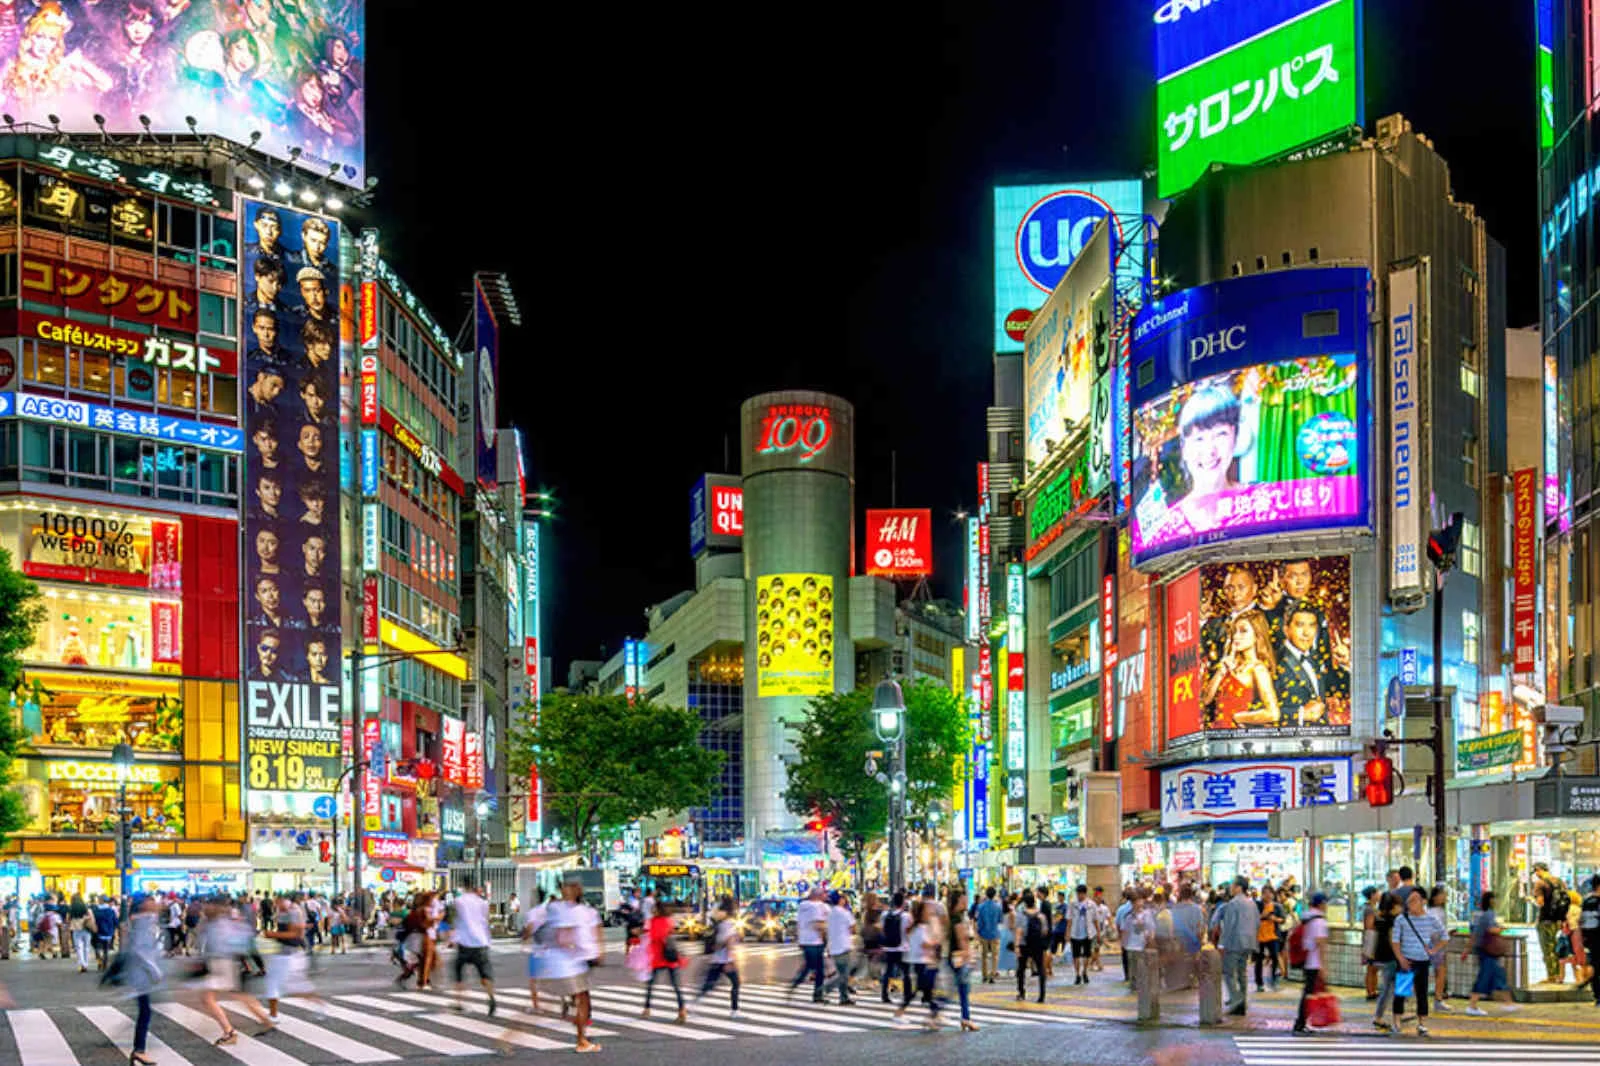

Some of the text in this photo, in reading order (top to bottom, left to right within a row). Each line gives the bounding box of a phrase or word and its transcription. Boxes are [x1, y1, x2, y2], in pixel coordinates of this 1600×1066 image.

[1164, 43, 1339, 151] サロンパス
[23, 260, 193, 319] コンタクト
[1151, 300, 1189, 329] Channel
[144, 336, 220, 374] ガスト
[1190, 325, 1247, 362] DHC
[23, 396, 239, 445] AEON 英会話イーオン
[1393, 304, 1414, 508] Taisei neon
[756, 417, 833, 463] 109
[717, 492, 743, 510] UN
[40, 511, 134, 545] 1000%
[879, 516, 918, 542] H&M
[41, 536, 134, 559] WEDDING!
[895, 557, 924, 567] 150m
[248, 681, 341, 729] EXILE
[1173, 672, 1194, 704] FX
[249, 738, 340, 757] NEW SINGLE
[290, 728, 315, 740] GOLD
[249, 754, 305, 790] 8.19
[305, 766, 322, 778] ON
